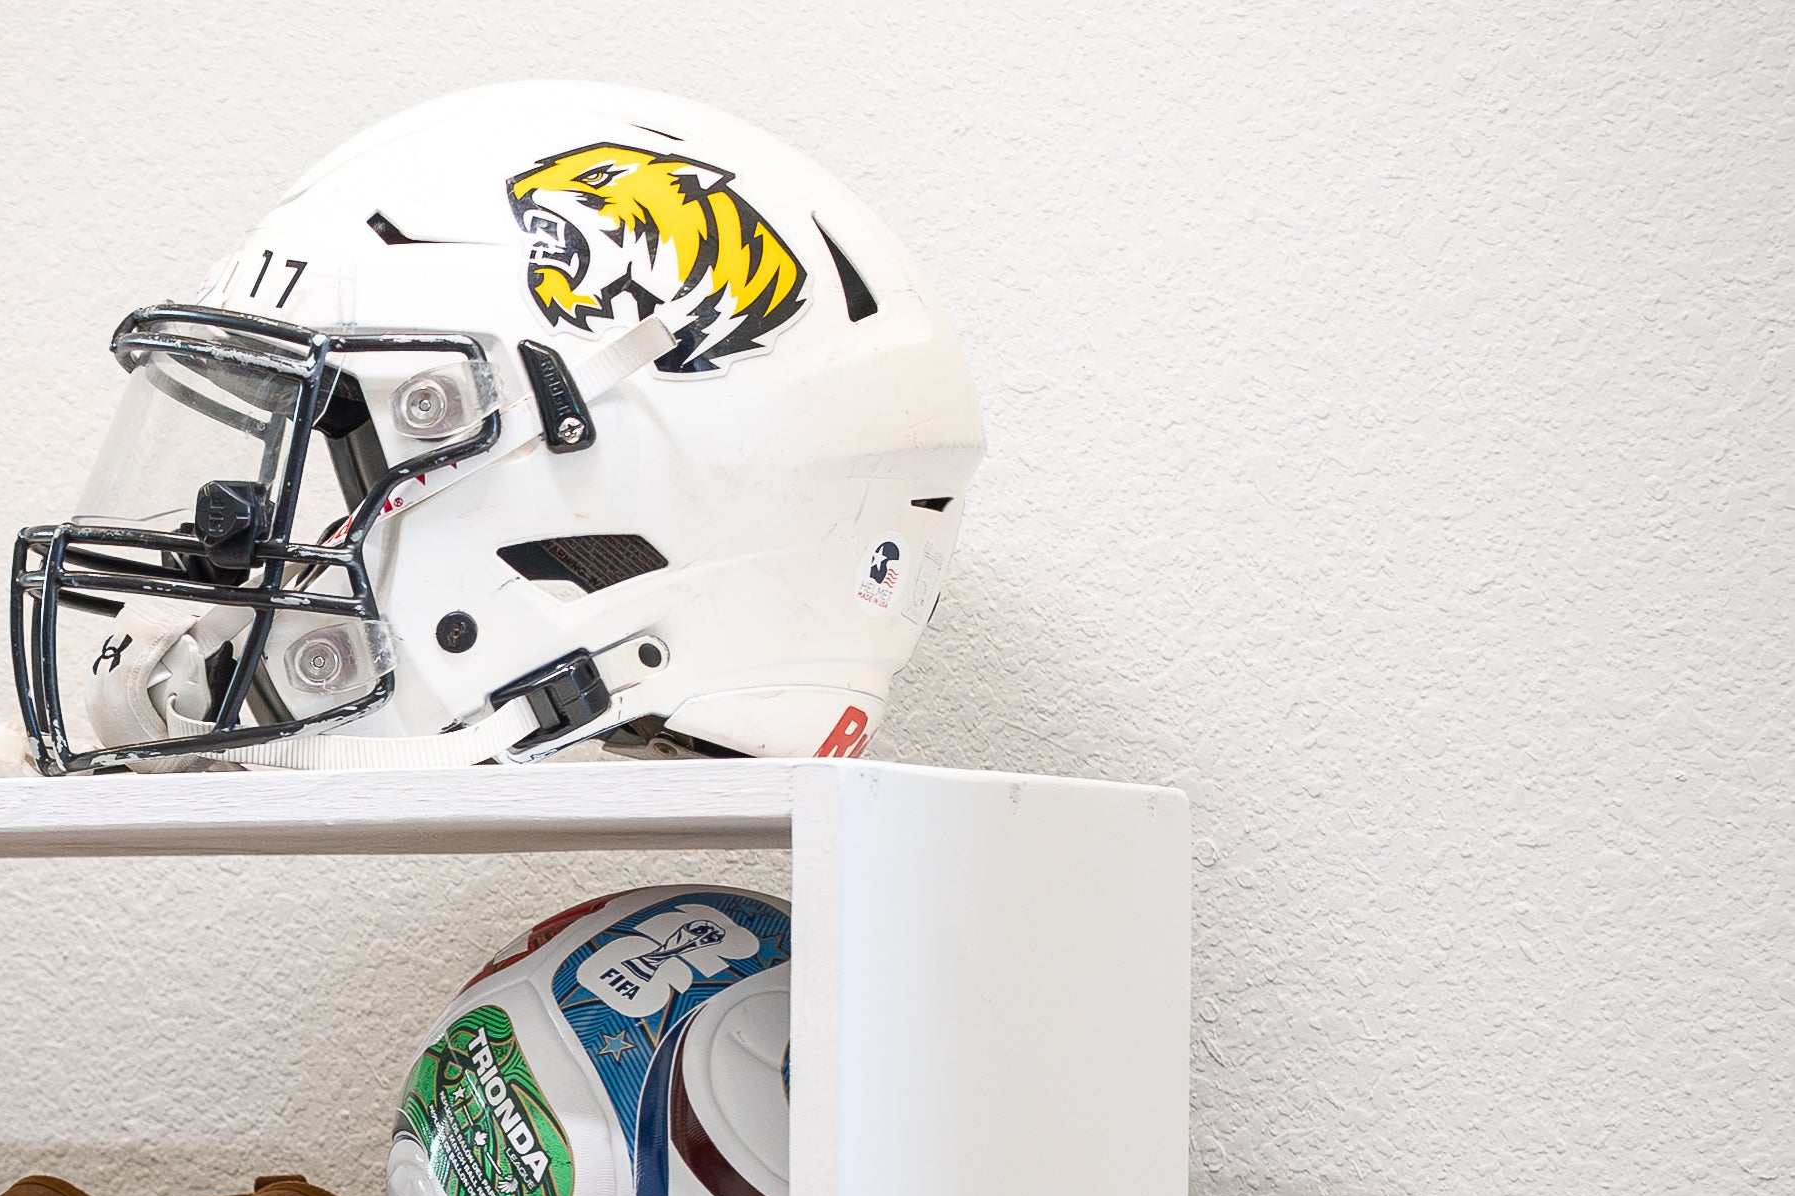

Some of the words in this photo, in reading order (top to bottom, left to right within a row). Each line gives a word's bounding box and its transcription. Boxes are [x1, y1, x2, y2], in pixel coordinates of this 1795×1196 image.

[250, 249, 308, 309] 17
[600, 967, 640, 1001] FIFA
[468, 1027, 549, 1183] TRIONDA
[449, 1133, 466, 1166] MATCH
[465, 1164, 477, 1188] BALL
[449, 1153, 469, 1188] BALLON
[471, 1160, 483, 1180] DEL
[506, 1147, 537, 1190] LEAGUE
